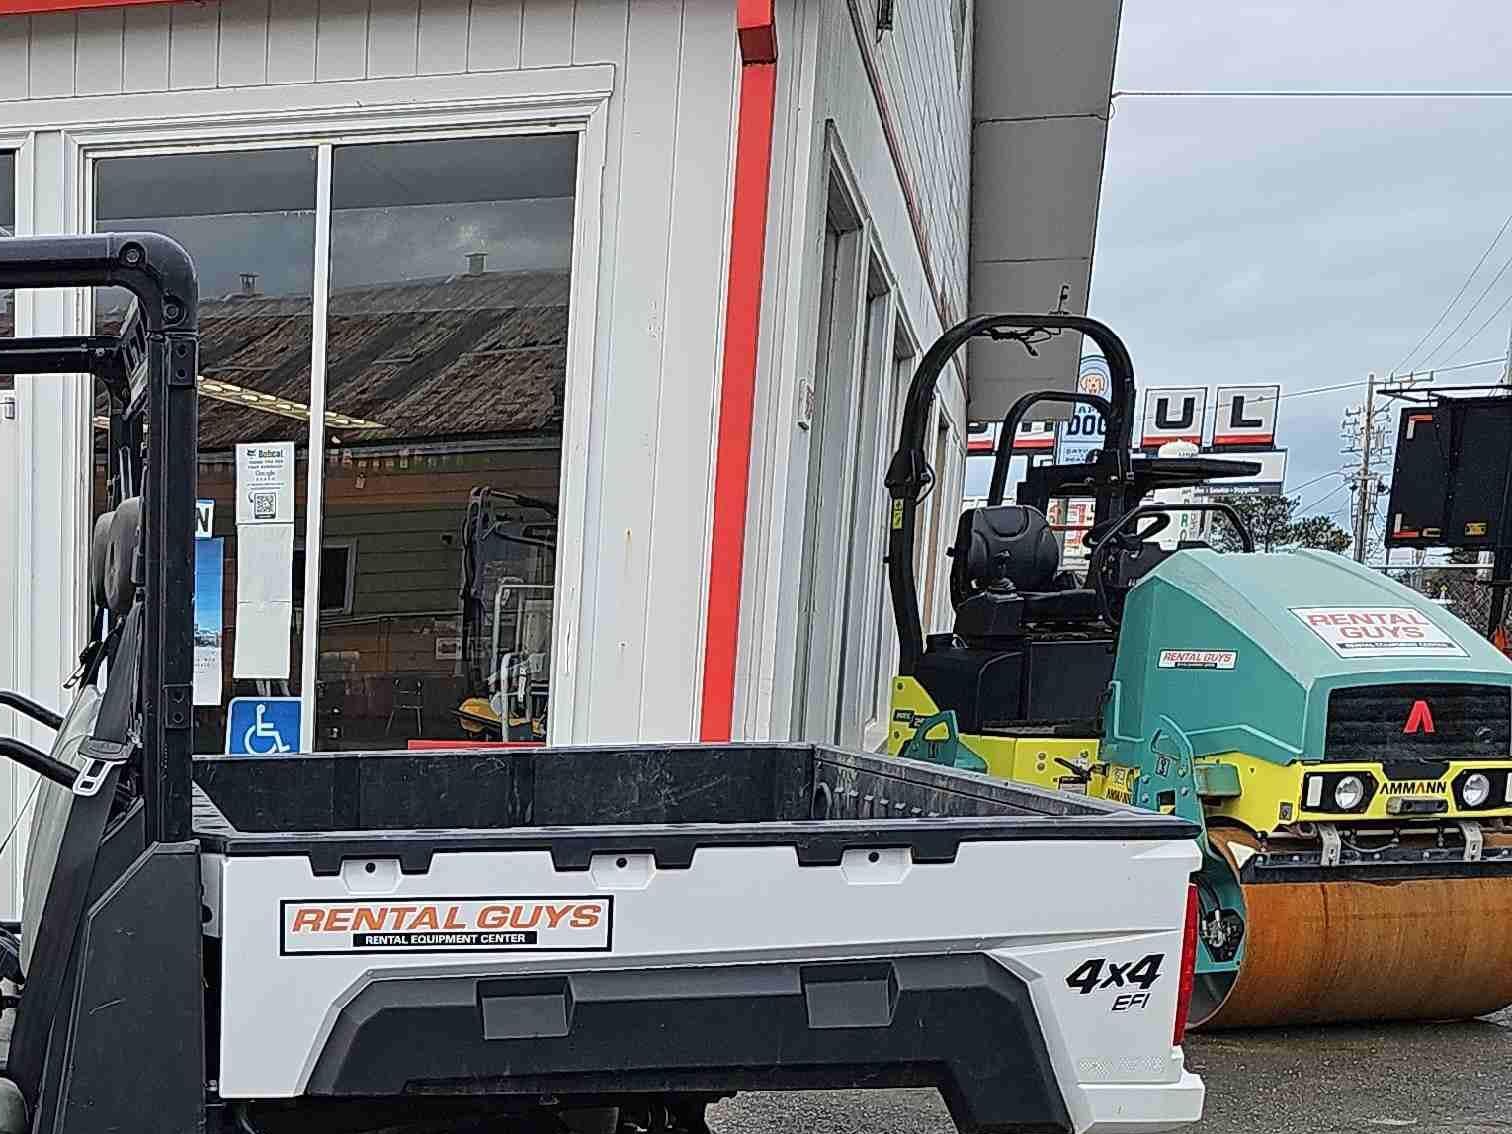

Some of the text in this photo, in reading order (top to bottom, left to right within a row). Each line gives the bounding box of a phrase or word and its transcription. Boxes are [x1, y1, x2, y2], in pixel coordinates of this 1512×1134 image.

[1307, 613, 1430, 626] RENTAL
[1340, 626, 1424, 639] GUYS
[1163, 652, 1202, 662] RENTAL
[1380, 781, 1448, 795] AMMANN
[292, 904, 602, 933] RENTAL GUYS
[365, 933, 526, 945] RENTAL EQUIPMENT CENTER
[1065, 953, 1166, 995] 4x4
[1111, 992, 1151, 1011] EFI
